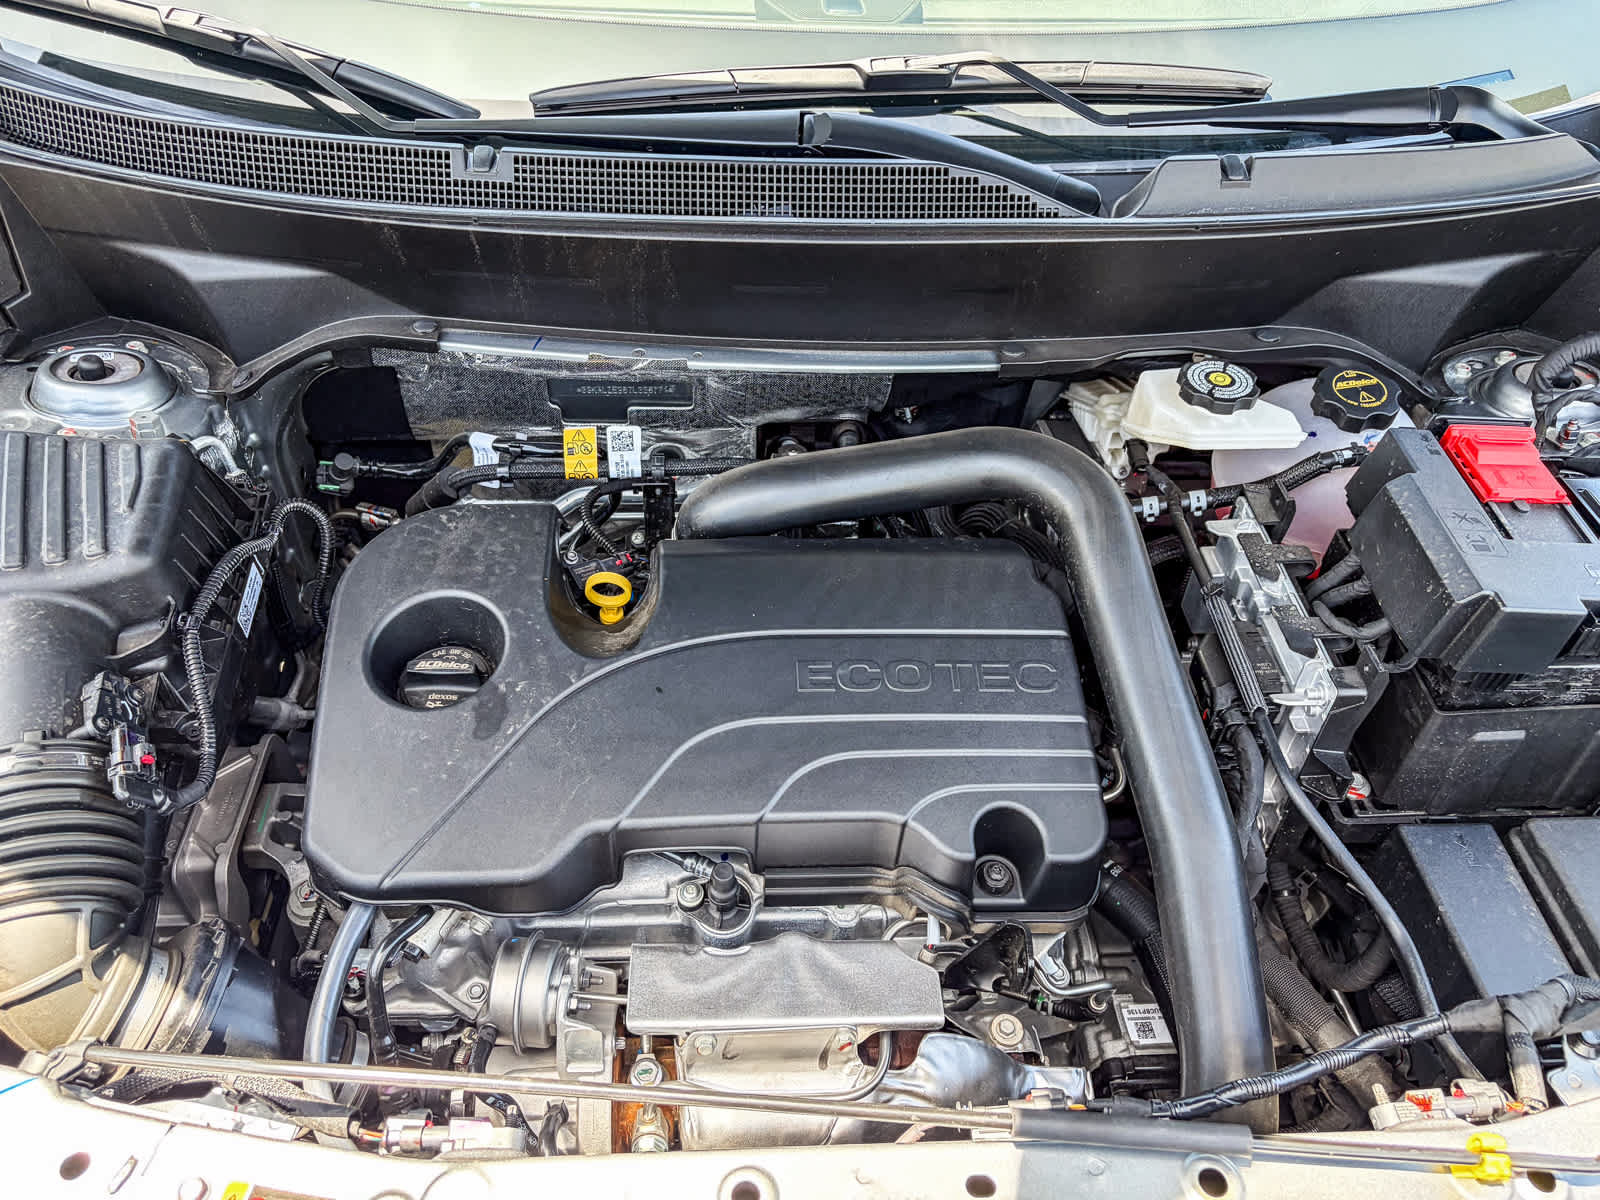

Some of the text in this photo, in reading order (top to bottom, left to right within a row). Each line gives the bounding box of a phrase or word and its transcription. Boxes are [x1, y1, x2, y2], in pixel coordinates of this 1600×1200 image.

[415, 660, 470, 670] ACDelco
[795, 660, 1059, 693] ECOTEC
[428, 693, 458, 701] dexos
